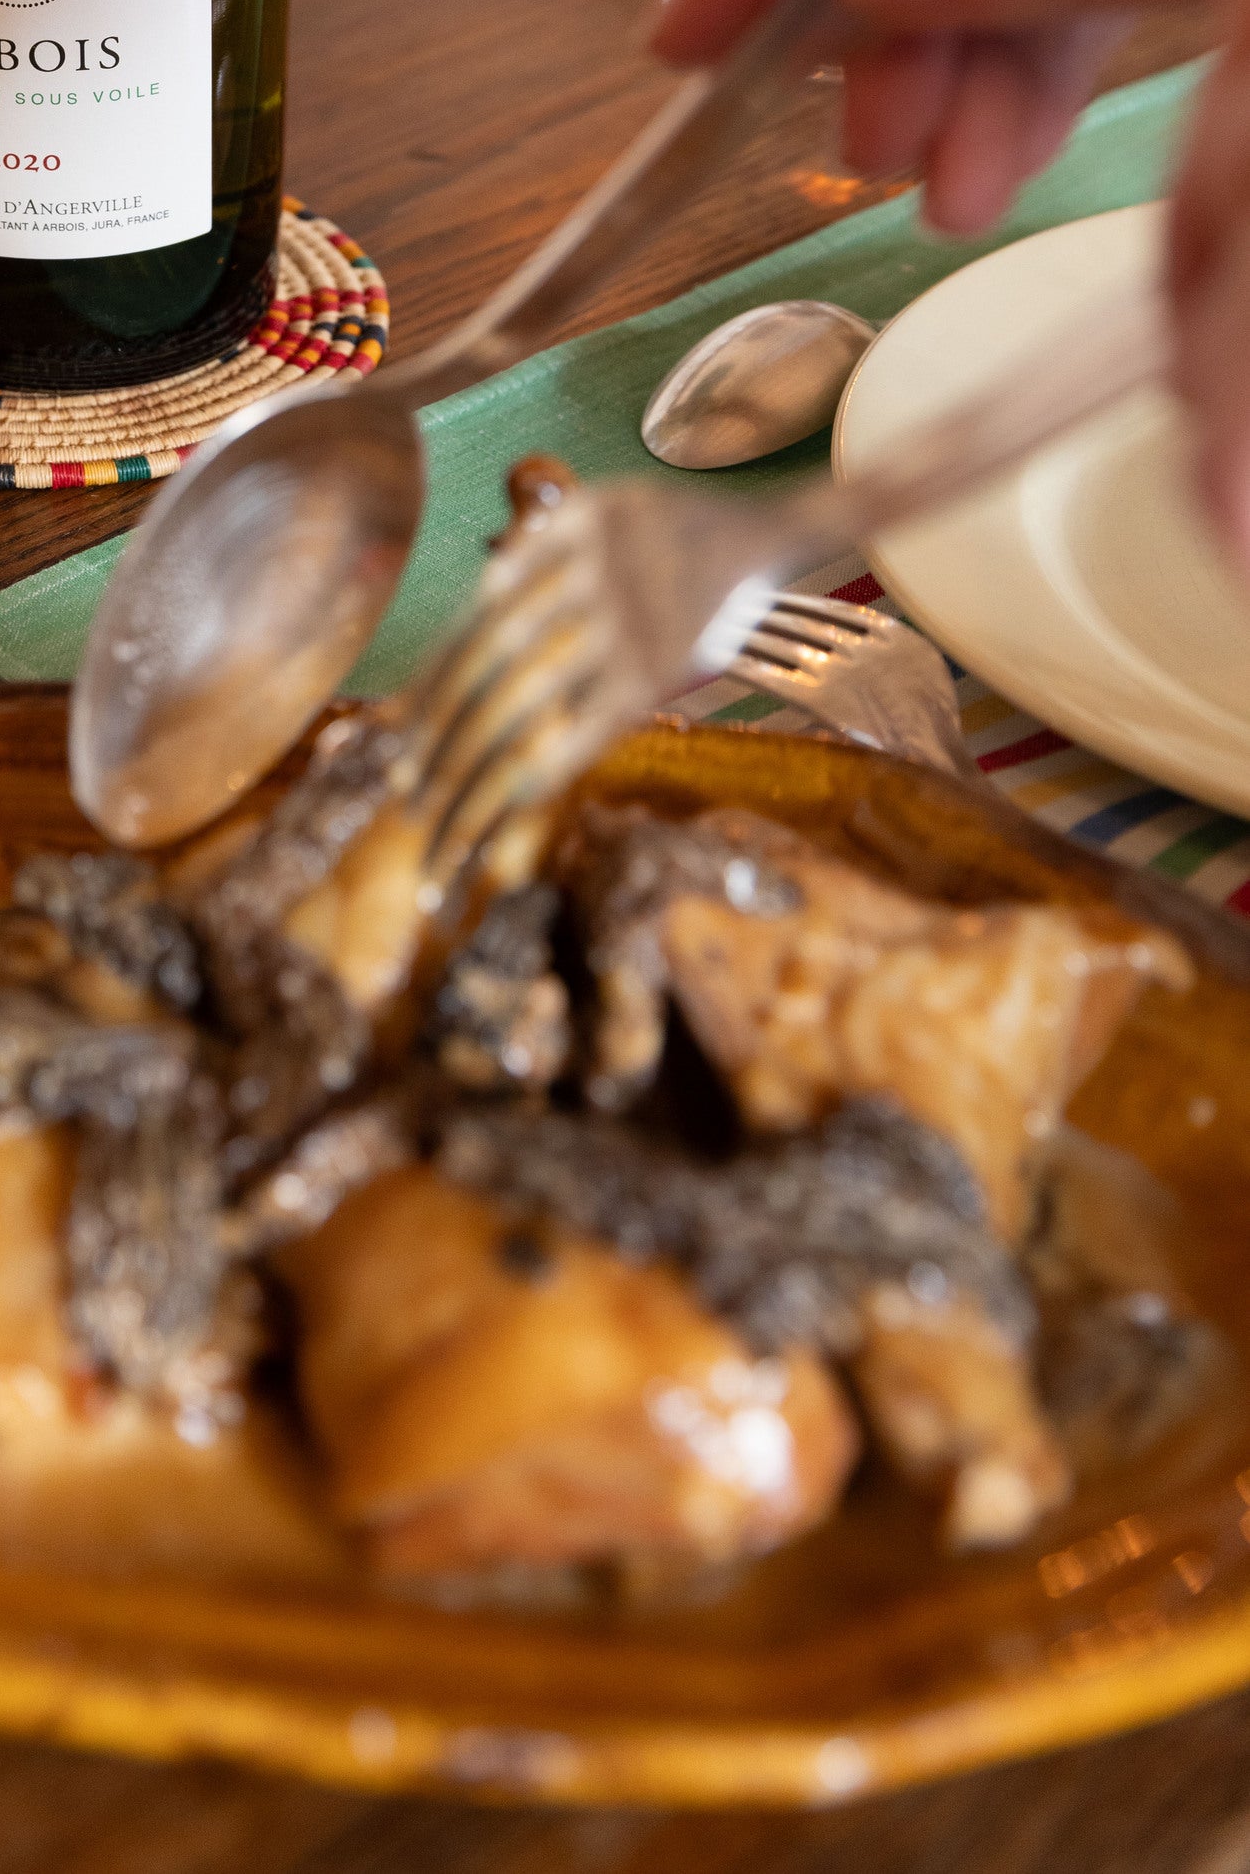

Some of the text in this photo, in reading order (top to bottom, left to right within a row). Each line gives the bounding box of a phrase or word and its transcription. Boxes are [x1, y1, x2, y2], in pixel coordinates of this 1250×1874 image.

[15, 92, 78, 106] SOUS
[93, 83, 160, 103] VOILE
[32, 221, 40, 232] À
[42, 222, 88, 232] ARBOIS,
[92, 219, 124, 230] JURA,
[127, 210, 170, 226] FRANCE
